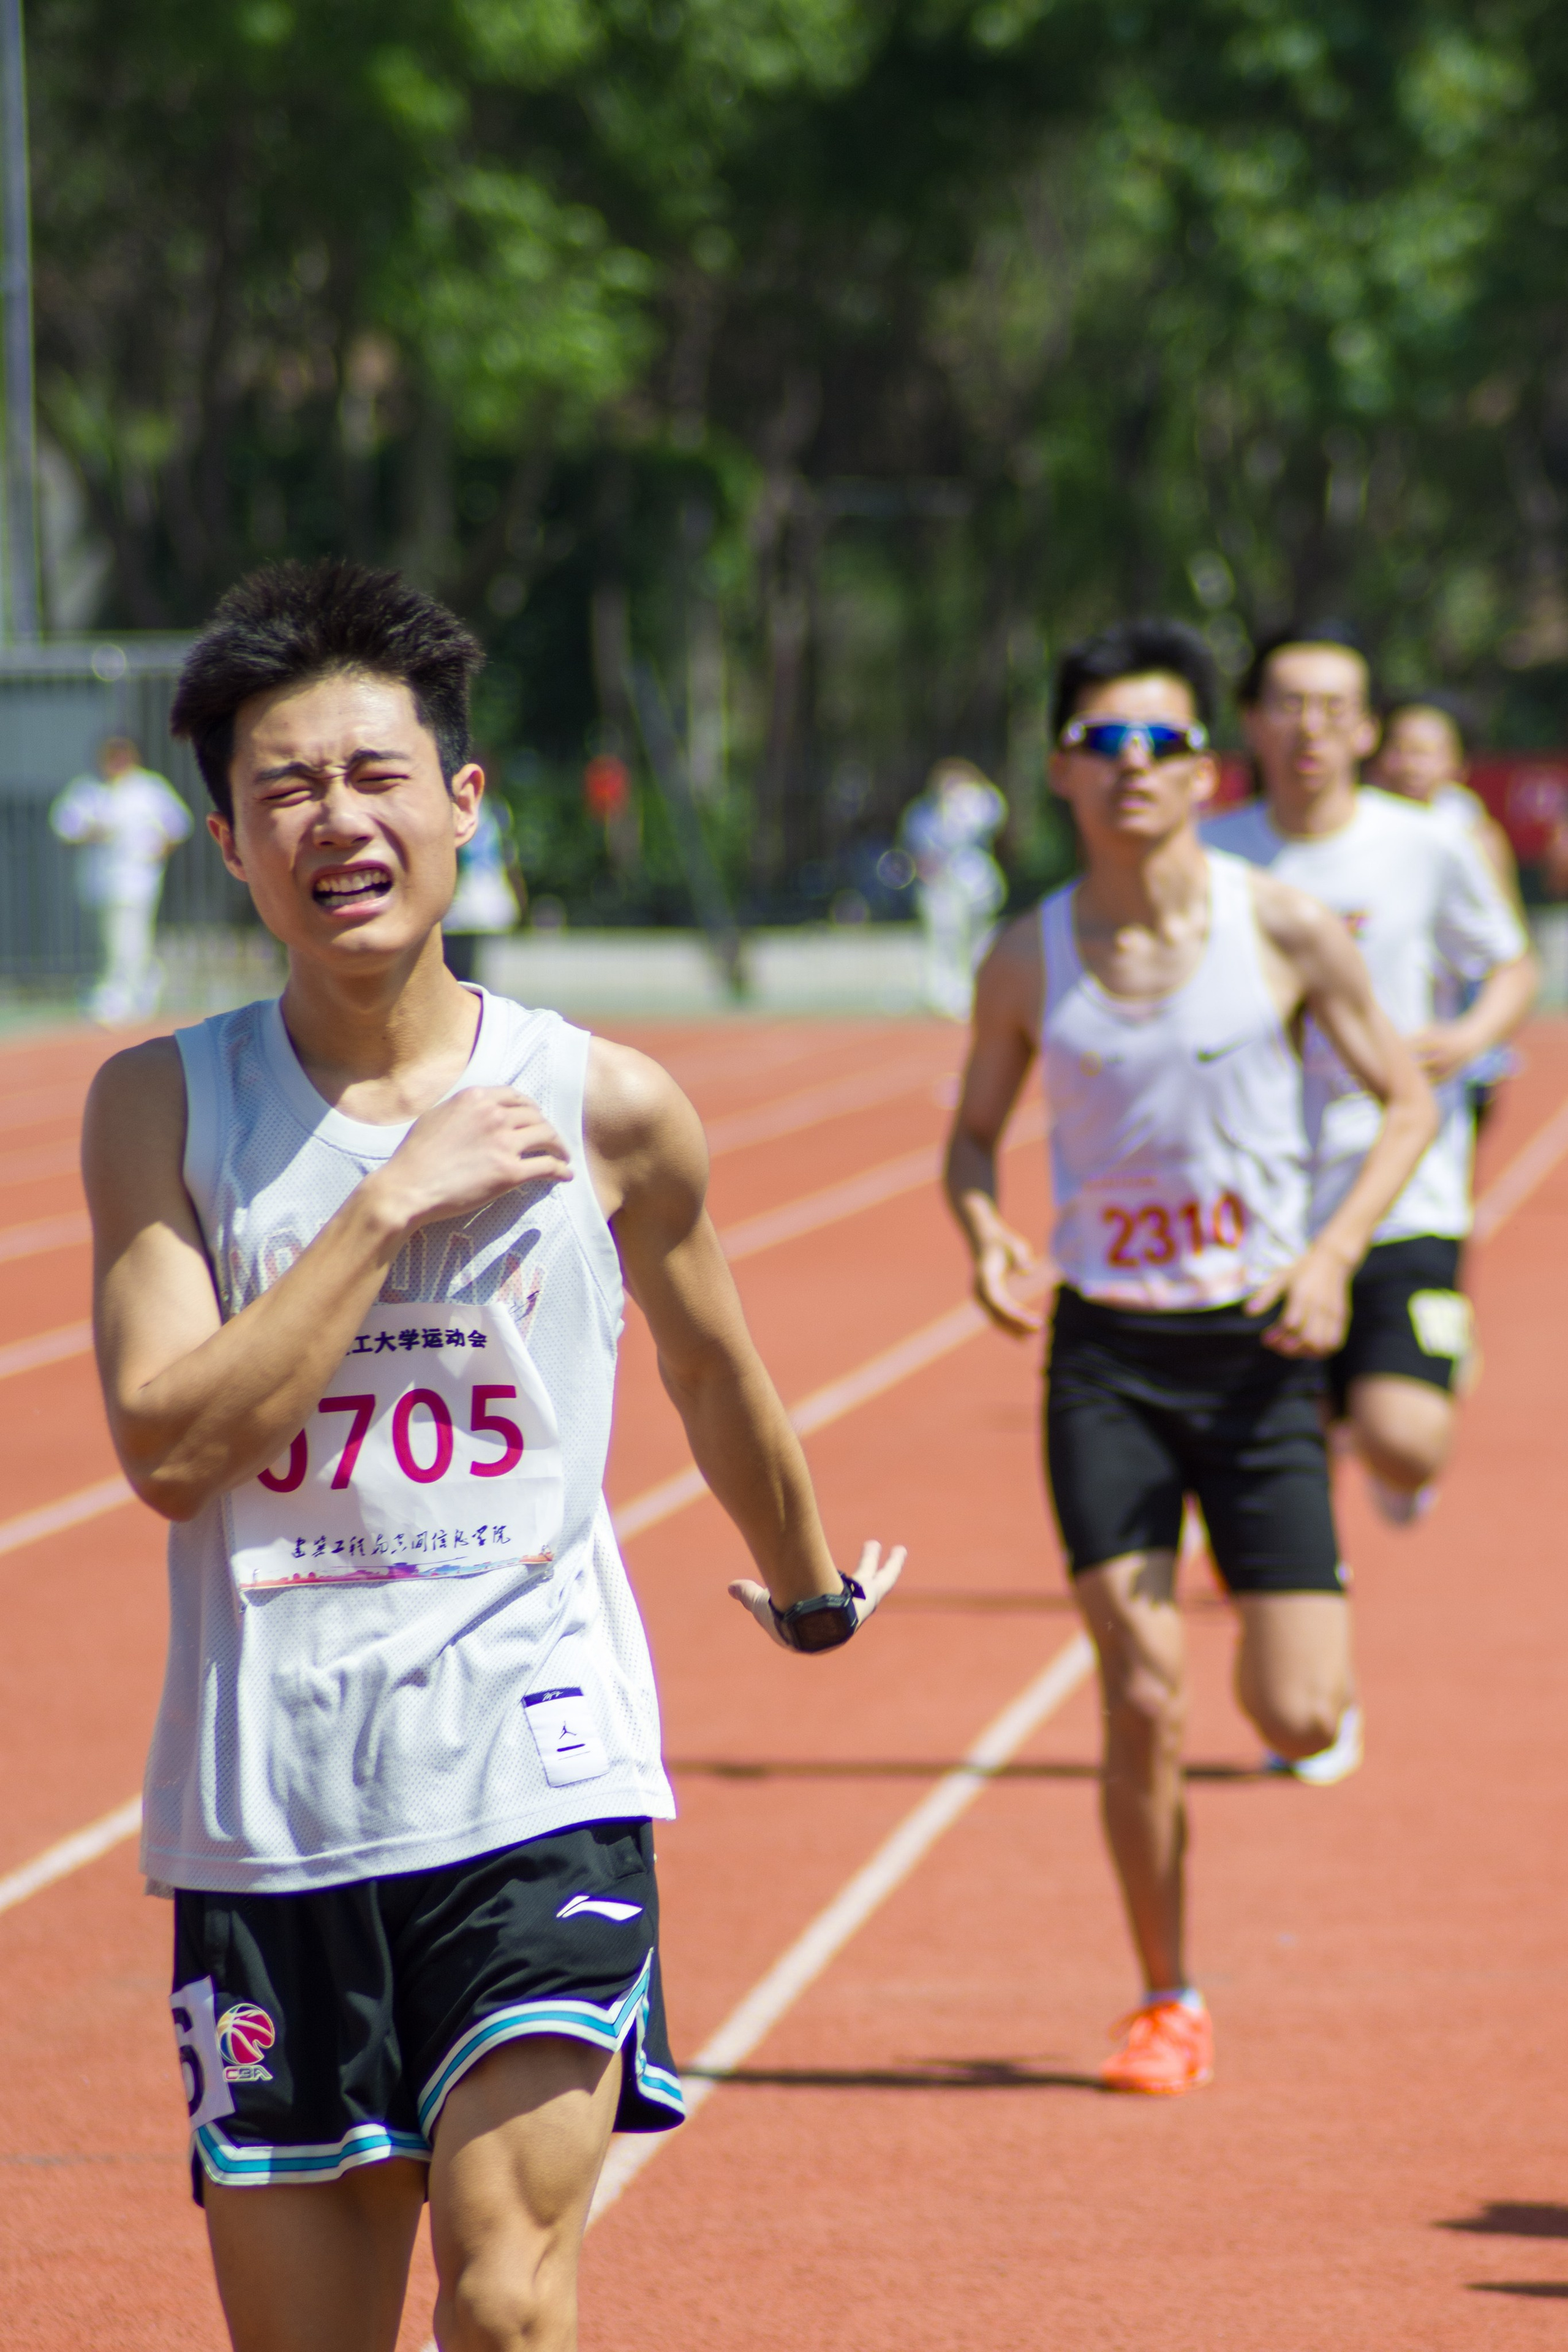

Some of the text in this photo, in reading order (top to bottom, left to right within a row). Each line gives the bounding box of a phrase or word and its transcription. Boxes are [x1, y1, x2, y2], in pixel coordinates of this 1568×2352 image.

[1102, 1193, 1244, 1267] 2310
[345, 1329, 488, 1355] 工大学运动会
[223, 2065, 273, 2082] CBA
